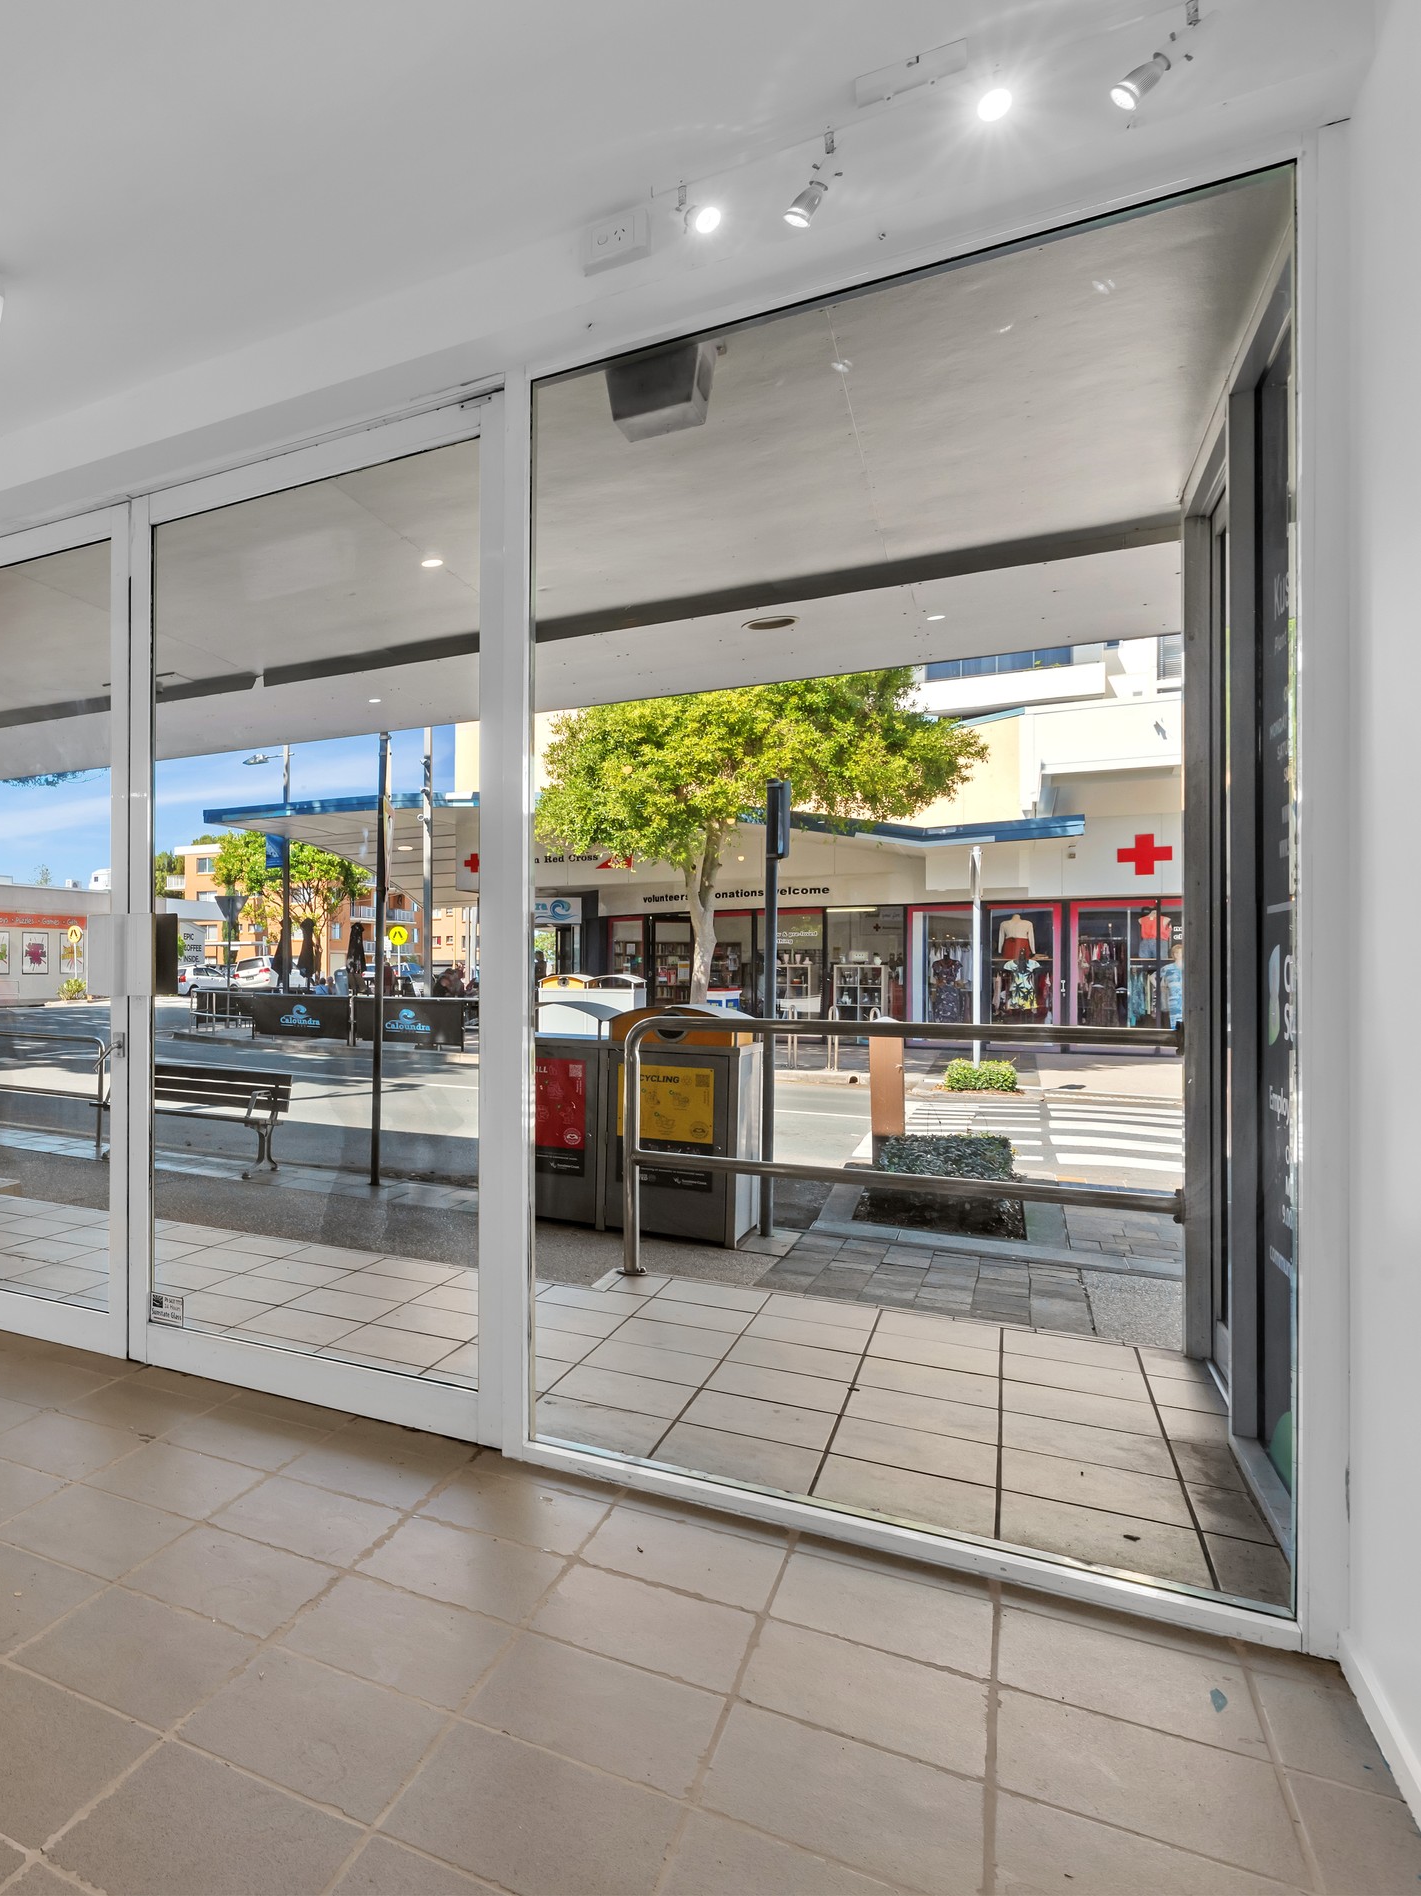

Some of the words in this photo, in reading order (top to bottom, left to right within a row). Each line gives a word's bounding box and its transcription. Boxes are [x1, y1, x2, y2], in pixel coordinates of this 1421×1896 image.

[543, 855, 565, 863] Red
[568, 854, 598, 864] Cross
[280, 1016, 320, 1026] Caloundra
[385, 1021, 430, 1031] Caloundra
